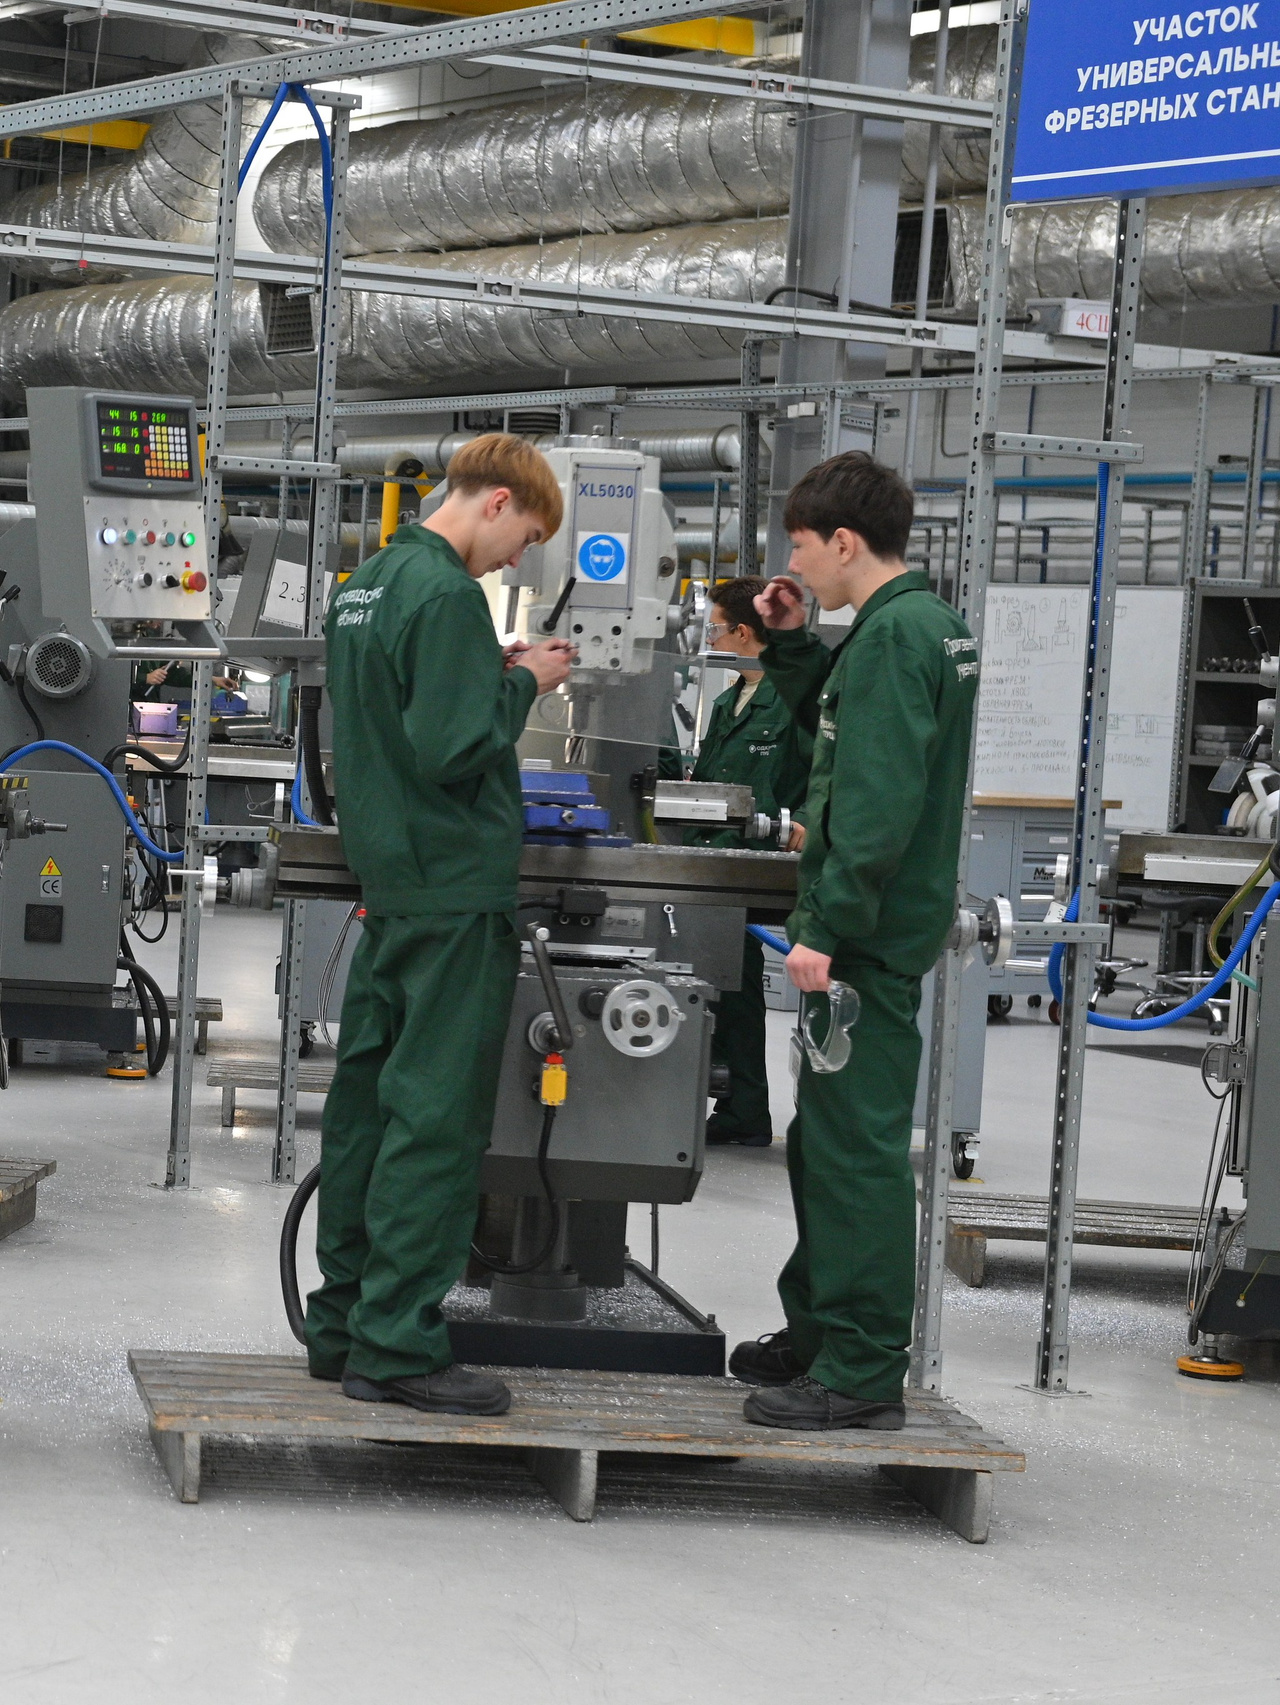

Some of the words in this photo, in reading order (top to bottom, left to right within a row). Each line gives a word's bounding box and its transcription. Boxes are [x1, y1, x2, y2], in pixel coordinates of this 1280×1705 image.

[1132, 3, 1260, 45] УЧАСТОК
[1044, 92, 1200, 134] ФРЕЗЕРНЫХ
[578, 482, 634, 499] XL5030
[278, 581, 306, 603] 2.3
[42, 880, 60, 894] CE
